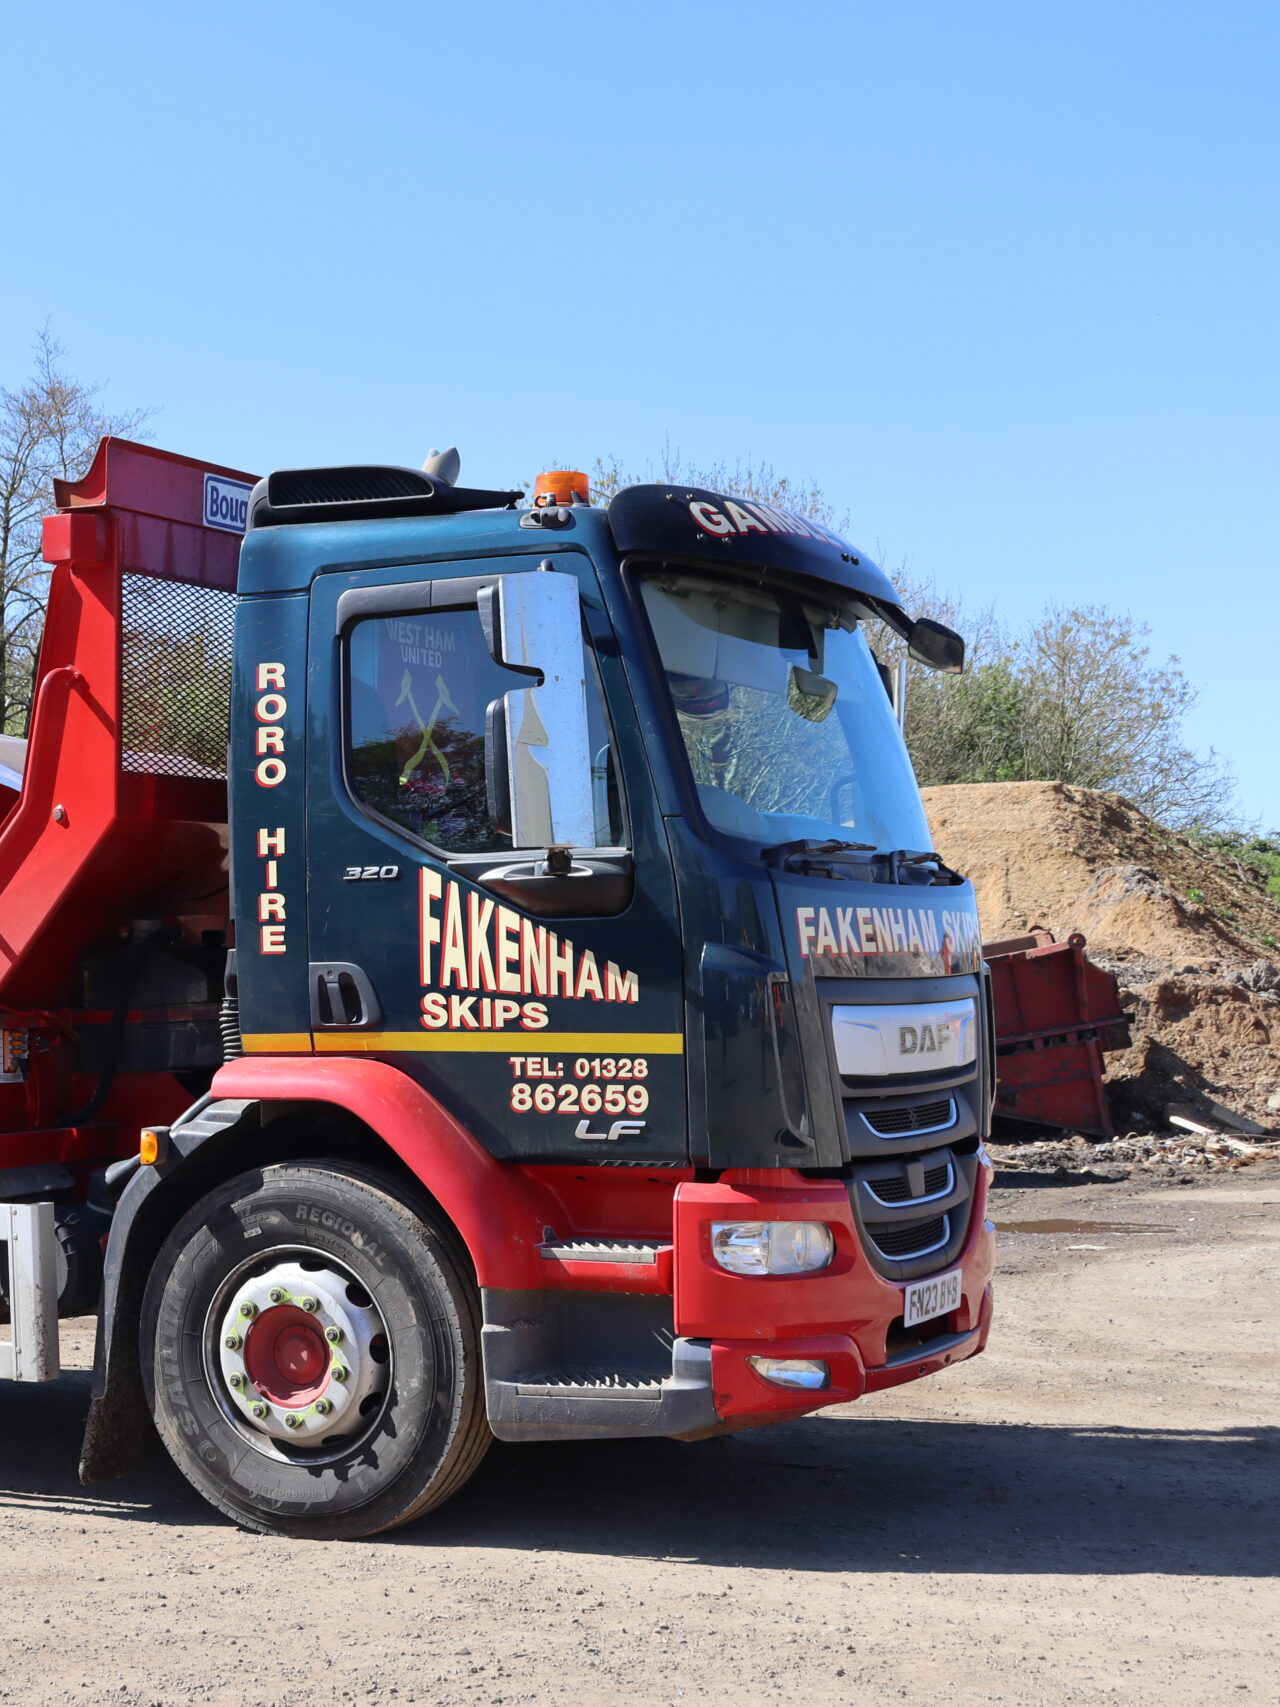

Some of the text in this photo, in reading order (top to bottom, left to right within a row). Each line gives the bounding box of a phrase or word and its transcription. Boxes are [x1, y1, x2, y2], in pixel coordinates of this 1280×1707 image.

[424, 627, 456, 652] HAM
[400, 646, 443, 668] UNITED
[255, 662, 287, 788] RORO
[343, 865, 399, 880] 320
[257, 828, 287, 954] HIRE
[419, 866, 639, 1004] FAKENHAM
[796, 907, 940, 958] FAKENHAM
[420, 993, 549, 1030] SKIPS
[899, 1023, 951, 1056] DAF
[509, 1057, 649, 1080] TEL: 01328
[509, 1083, 650, 1115] 862659
[575, 1120, 646, 1141] LF
[910, 1283, 938, 1320] FN23
